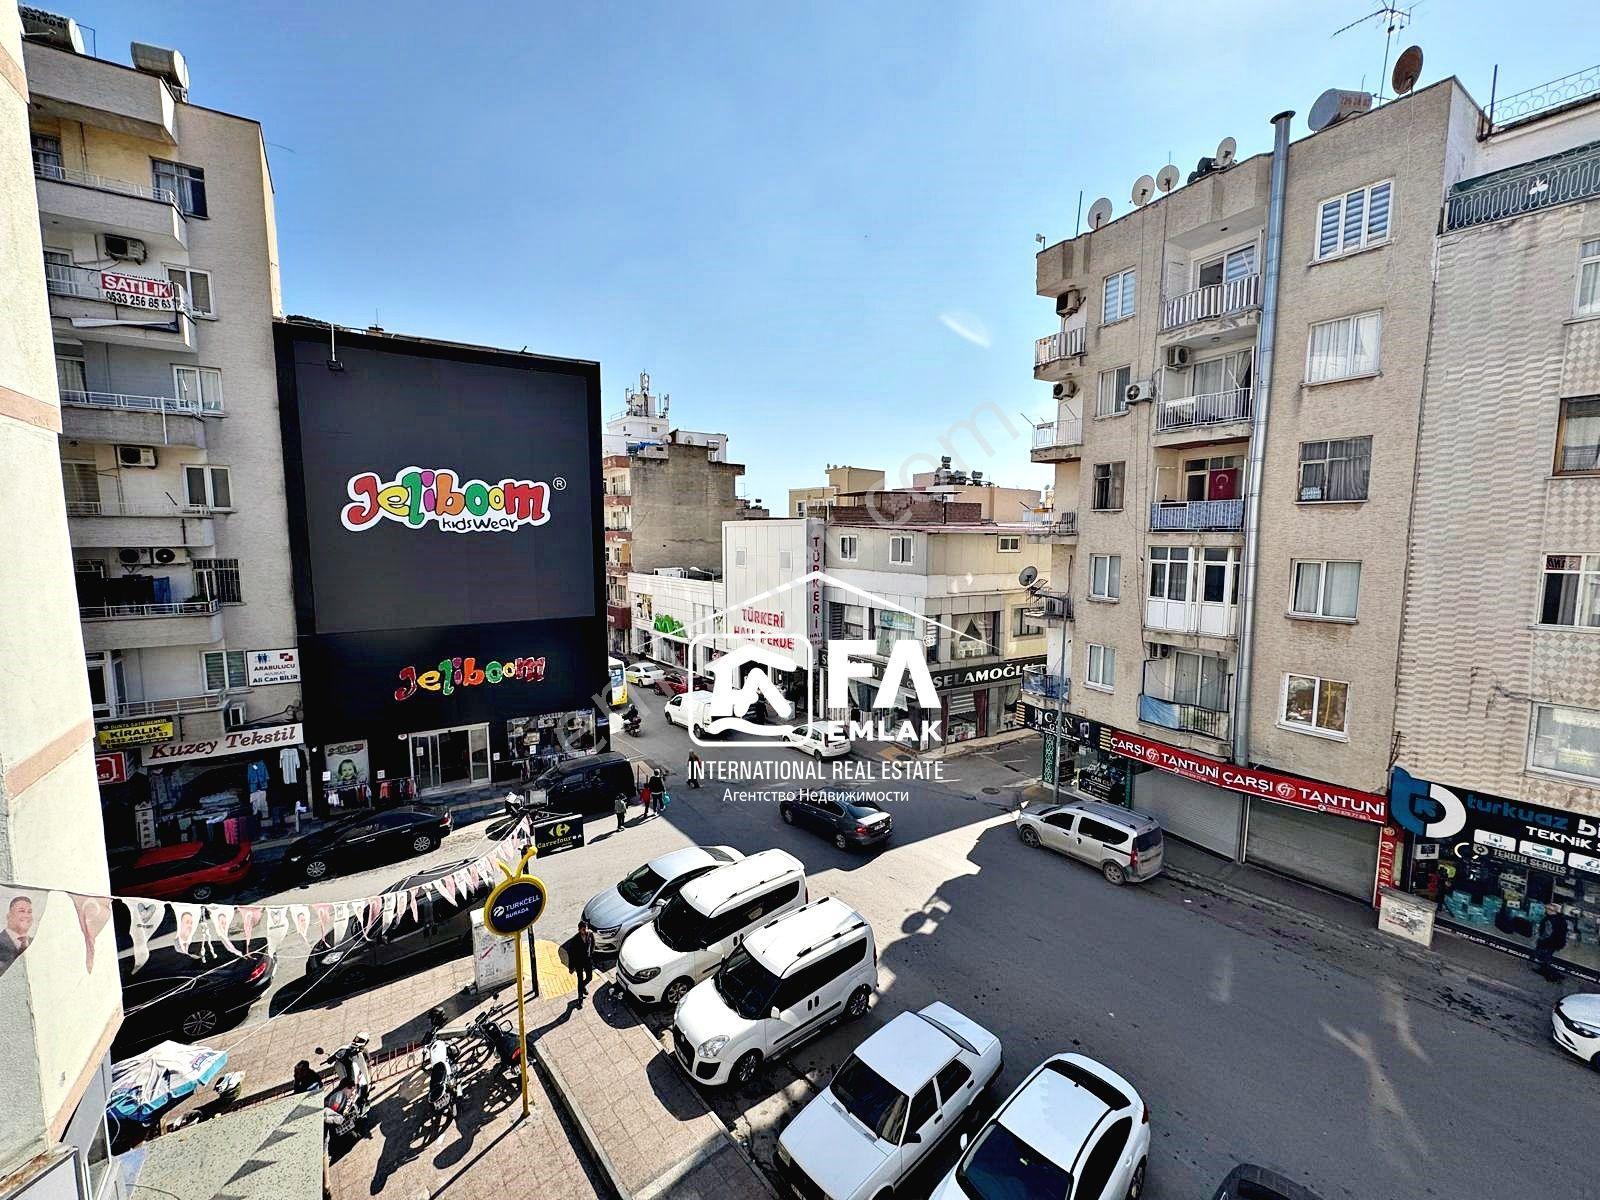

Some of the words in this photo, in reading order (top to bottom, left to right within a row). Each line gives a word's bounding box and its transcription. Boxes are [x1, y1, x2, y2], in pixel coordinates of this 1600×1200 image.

[104, 275, 170, 298] SATILIK
[105, 290, 127, 304] 0533
[130, 294, 146, 307] 256
[148, 297, 159, 309] 85
[161, 299, 171, 309] 63
[345, 468, 547, 528] Jeliboom
[742, 606, 785, 628] TÜRKERİ
[394, 655, 546, 701] Jeliboom
[932, 663, 1027, 688] SELAMOĞL
[1044, 712, 1073, 729] CN
[110, 726, 163, 739] KİRALIK
[149, 739, 218, 760] Kuzey
[225, 726, 296, 749] Tekstil
[1110, 737, 1145, 757] ÇARŞI
[1161, 752, 1219, 779] TANTUNİ
[1222, 771, 1273, 793] ÇARŞI
[1299, 787, 1385, 816] TANTUNİ
[1466, 794, 1569, 831] turkuaz
[1526, 826, 1592, 850] TEKNİK
[505, 895, 540, 911] TURKCELL
[505, 908, 529, 919] BURADA
